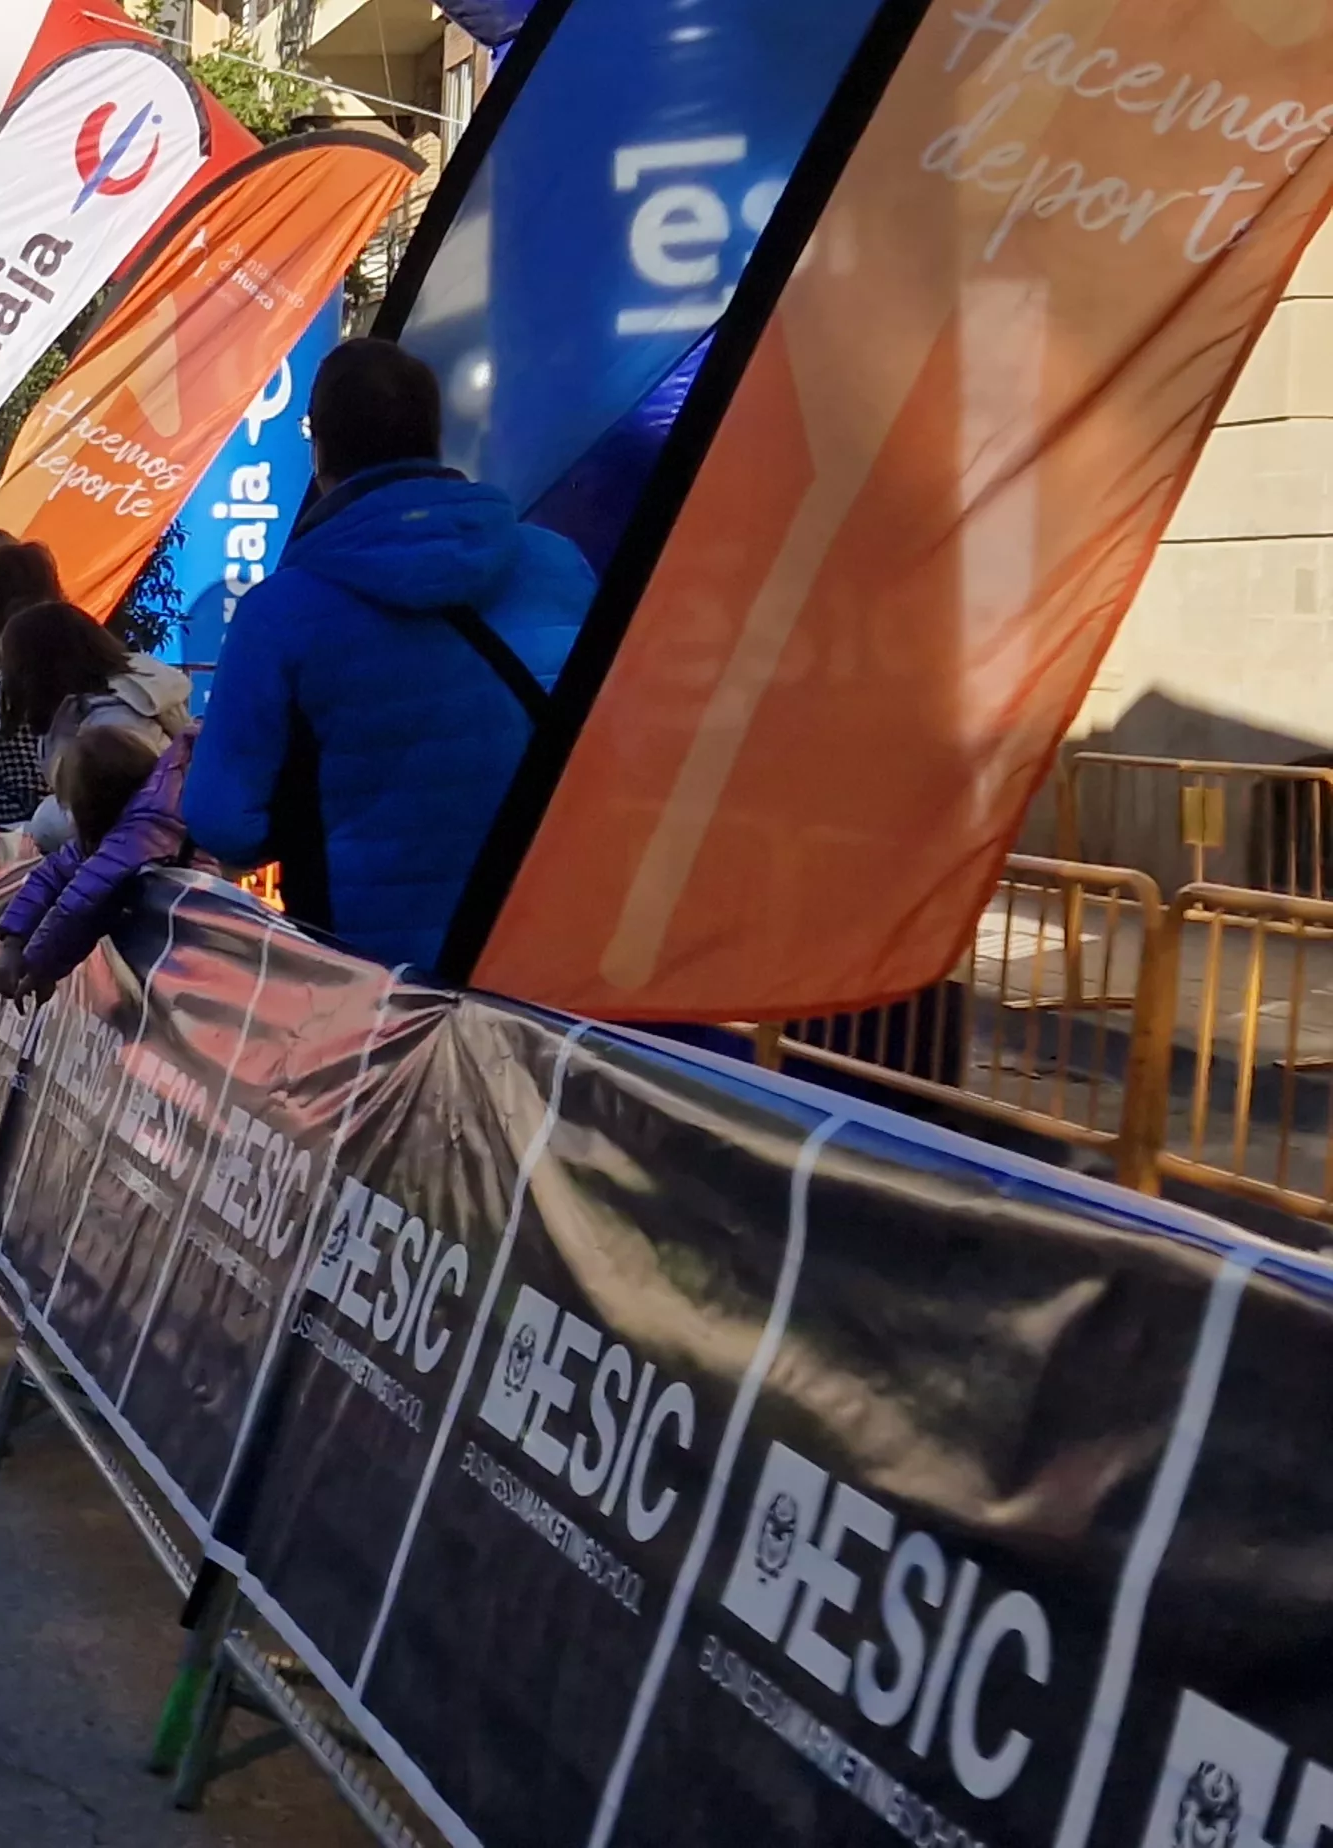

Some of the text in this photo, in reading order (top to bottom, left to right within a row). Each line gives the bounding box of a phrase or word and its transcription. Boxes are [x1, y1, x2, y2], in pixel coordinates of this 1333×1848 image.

[133, 1059, 207, 1181] ESIC
[221, 1117, 311, 1260] ESIC
[336, 1194, 468, 1373] ESIC
[521, 1310, 695, 1542] ESIC
[783, 1481, 1051, 1800] ESIC
